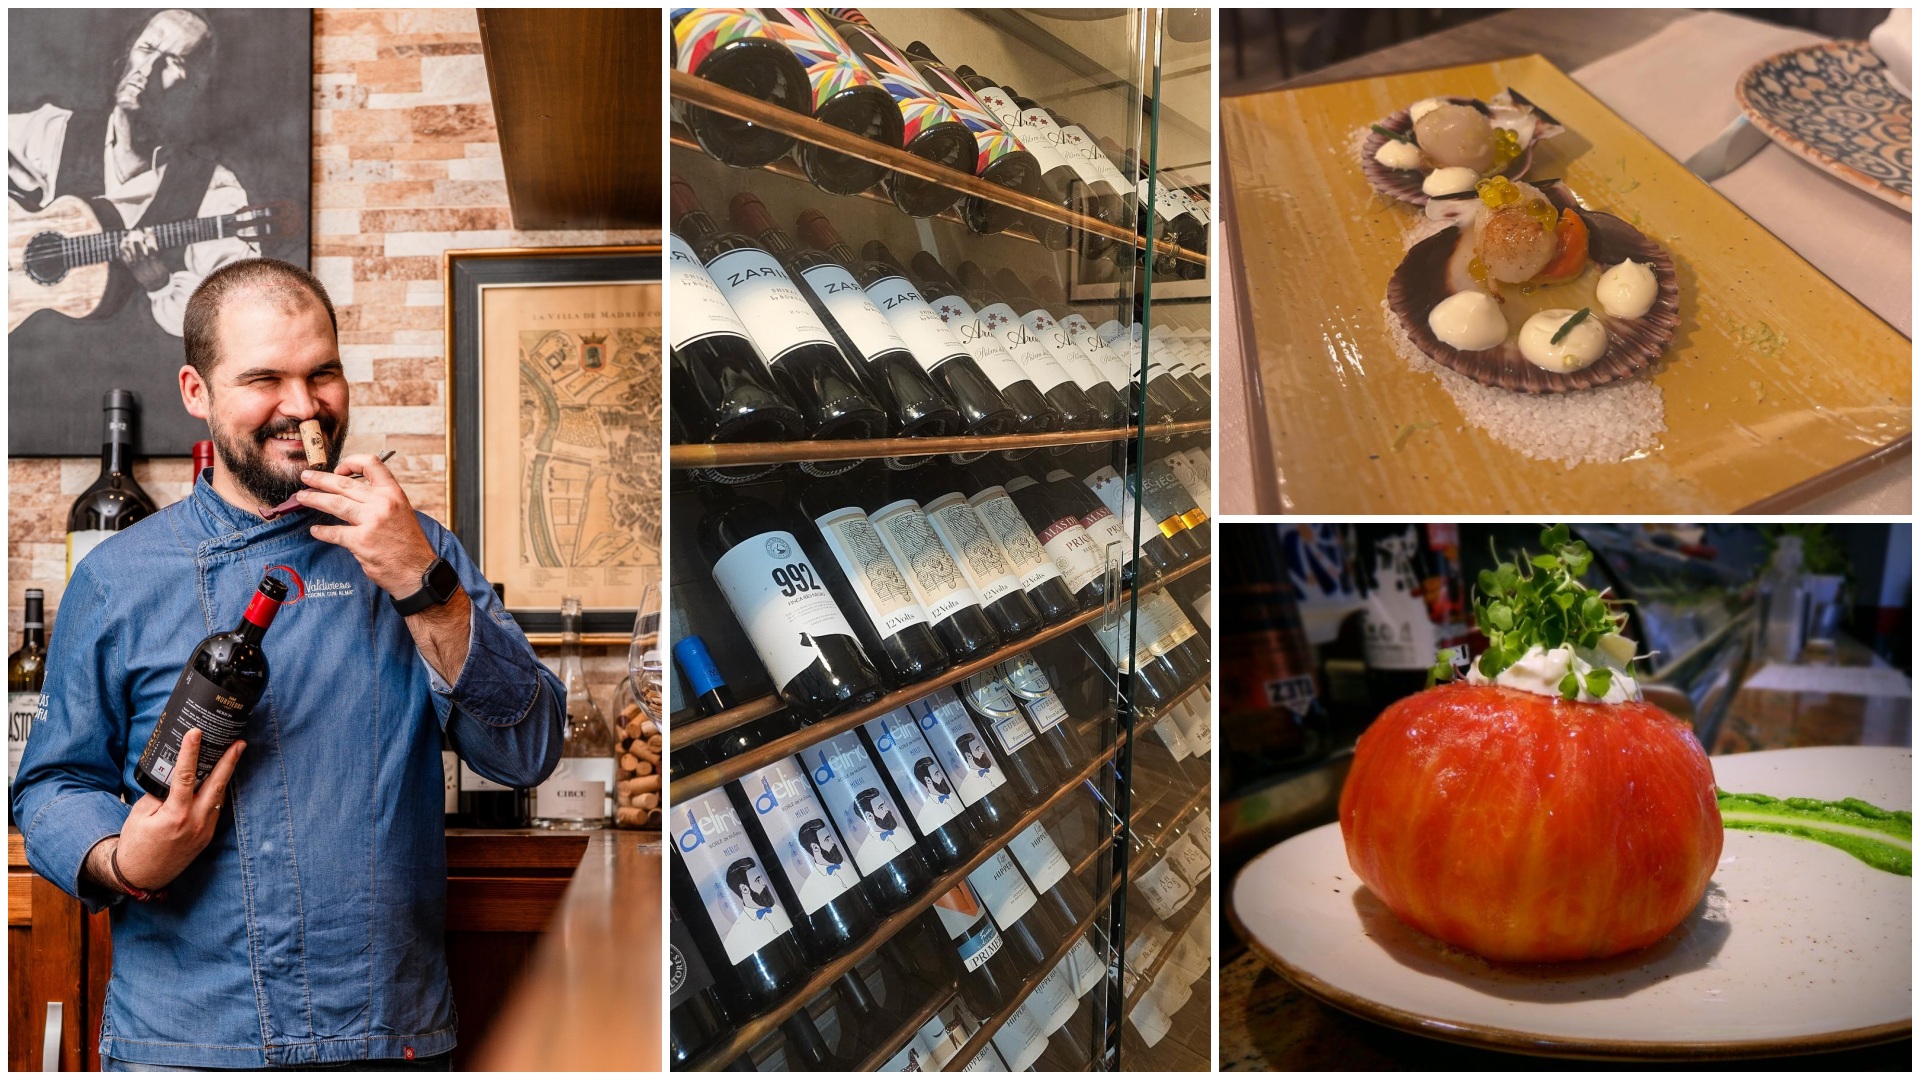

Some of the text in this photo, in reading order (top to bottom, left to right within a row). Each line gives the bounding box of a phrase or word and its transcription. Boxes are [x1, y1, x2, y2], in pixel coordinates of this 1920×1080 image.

[600, 311, 645, 319] MADRID
[771, 562, 821, 597] 992
[788, 596, 803, 606] FINCA
[8, 711, 37, 741] ASTO
[557, 789, 587, 798] CIRCE
